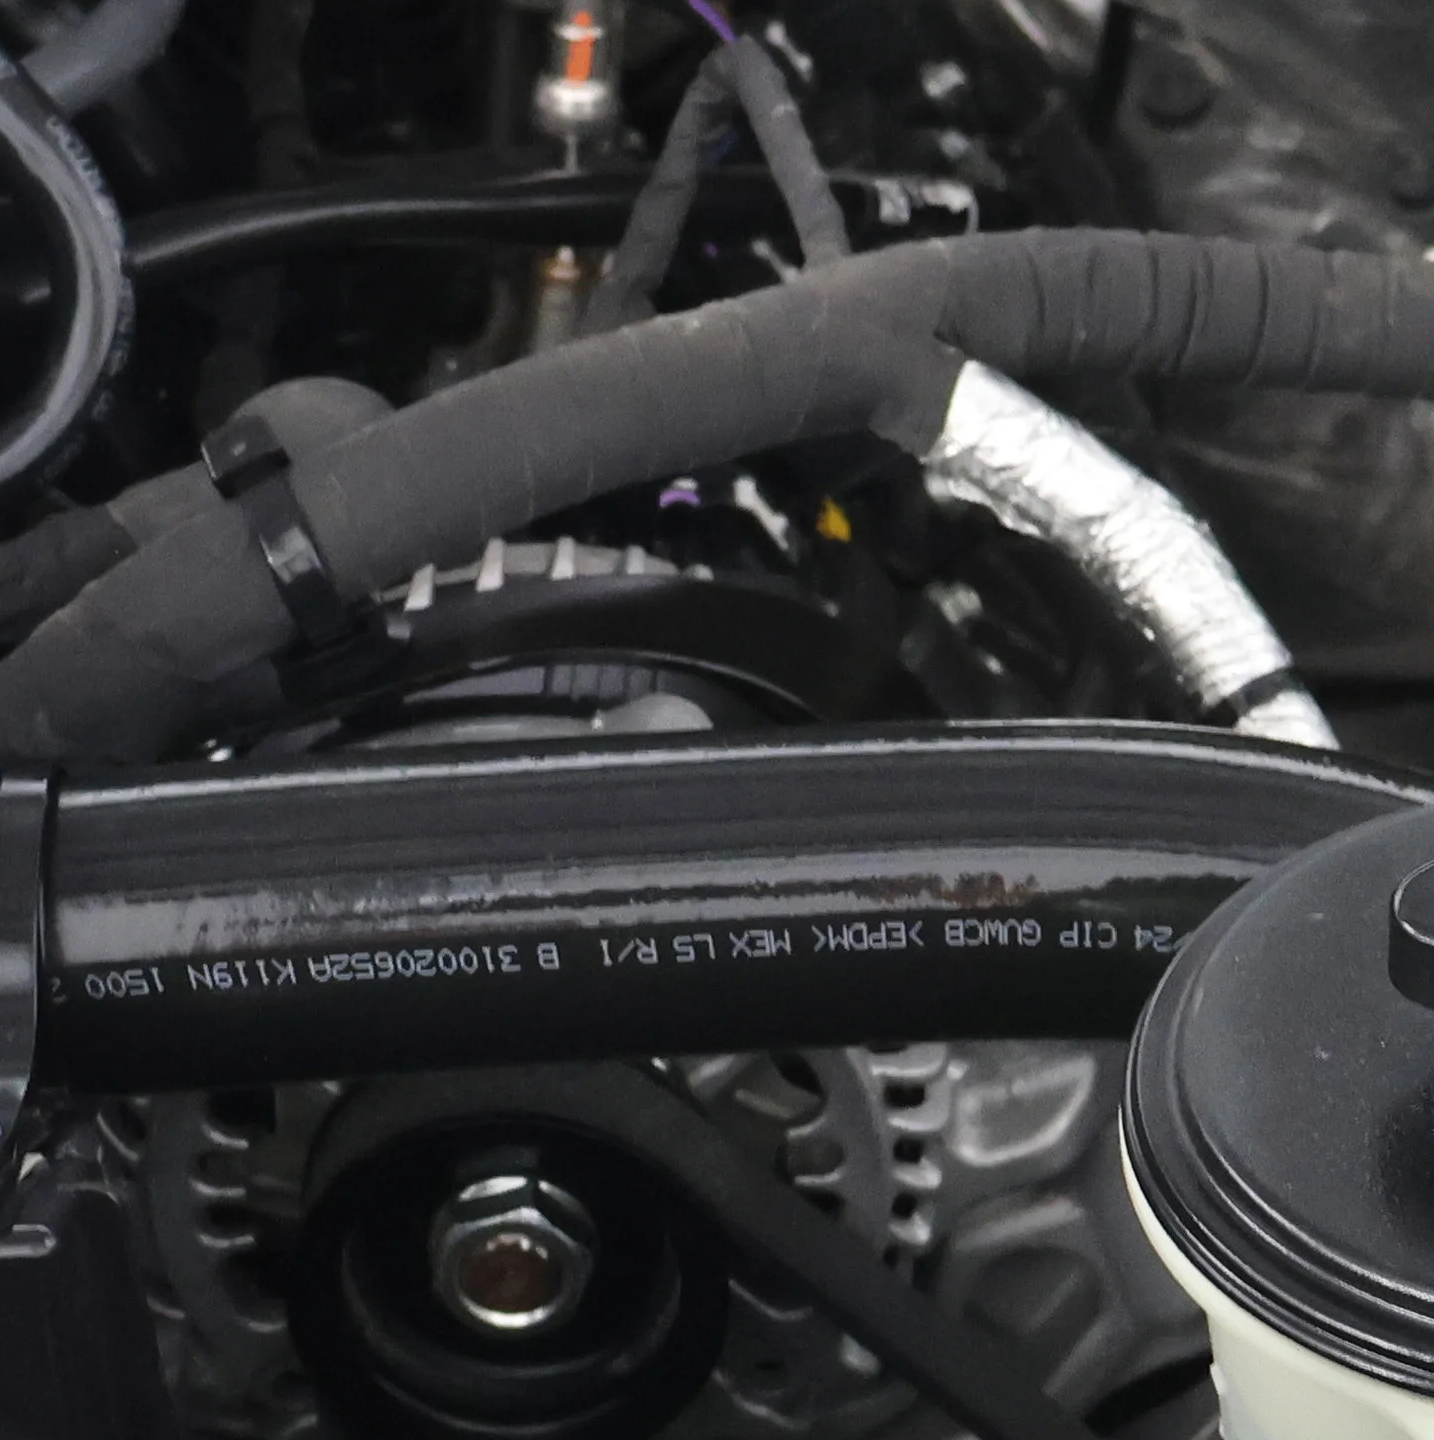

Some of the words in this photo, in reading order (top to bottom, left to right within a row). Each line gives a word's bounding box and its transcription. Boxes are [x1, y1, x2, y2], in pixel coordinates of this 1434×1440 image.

[729, 928, 792, 958] MEX
[810, 920, 924, 952] >EPDM<
[944, 918, 1041, 947] GUWCB
[1059, 920, 1117, 949] CIP
[307, 944, 521, 984] 310020652A
[537, 942, 560, 971] B
[85, 966, 165, 999] 1500
[186, 957, 297, 990] K119N
